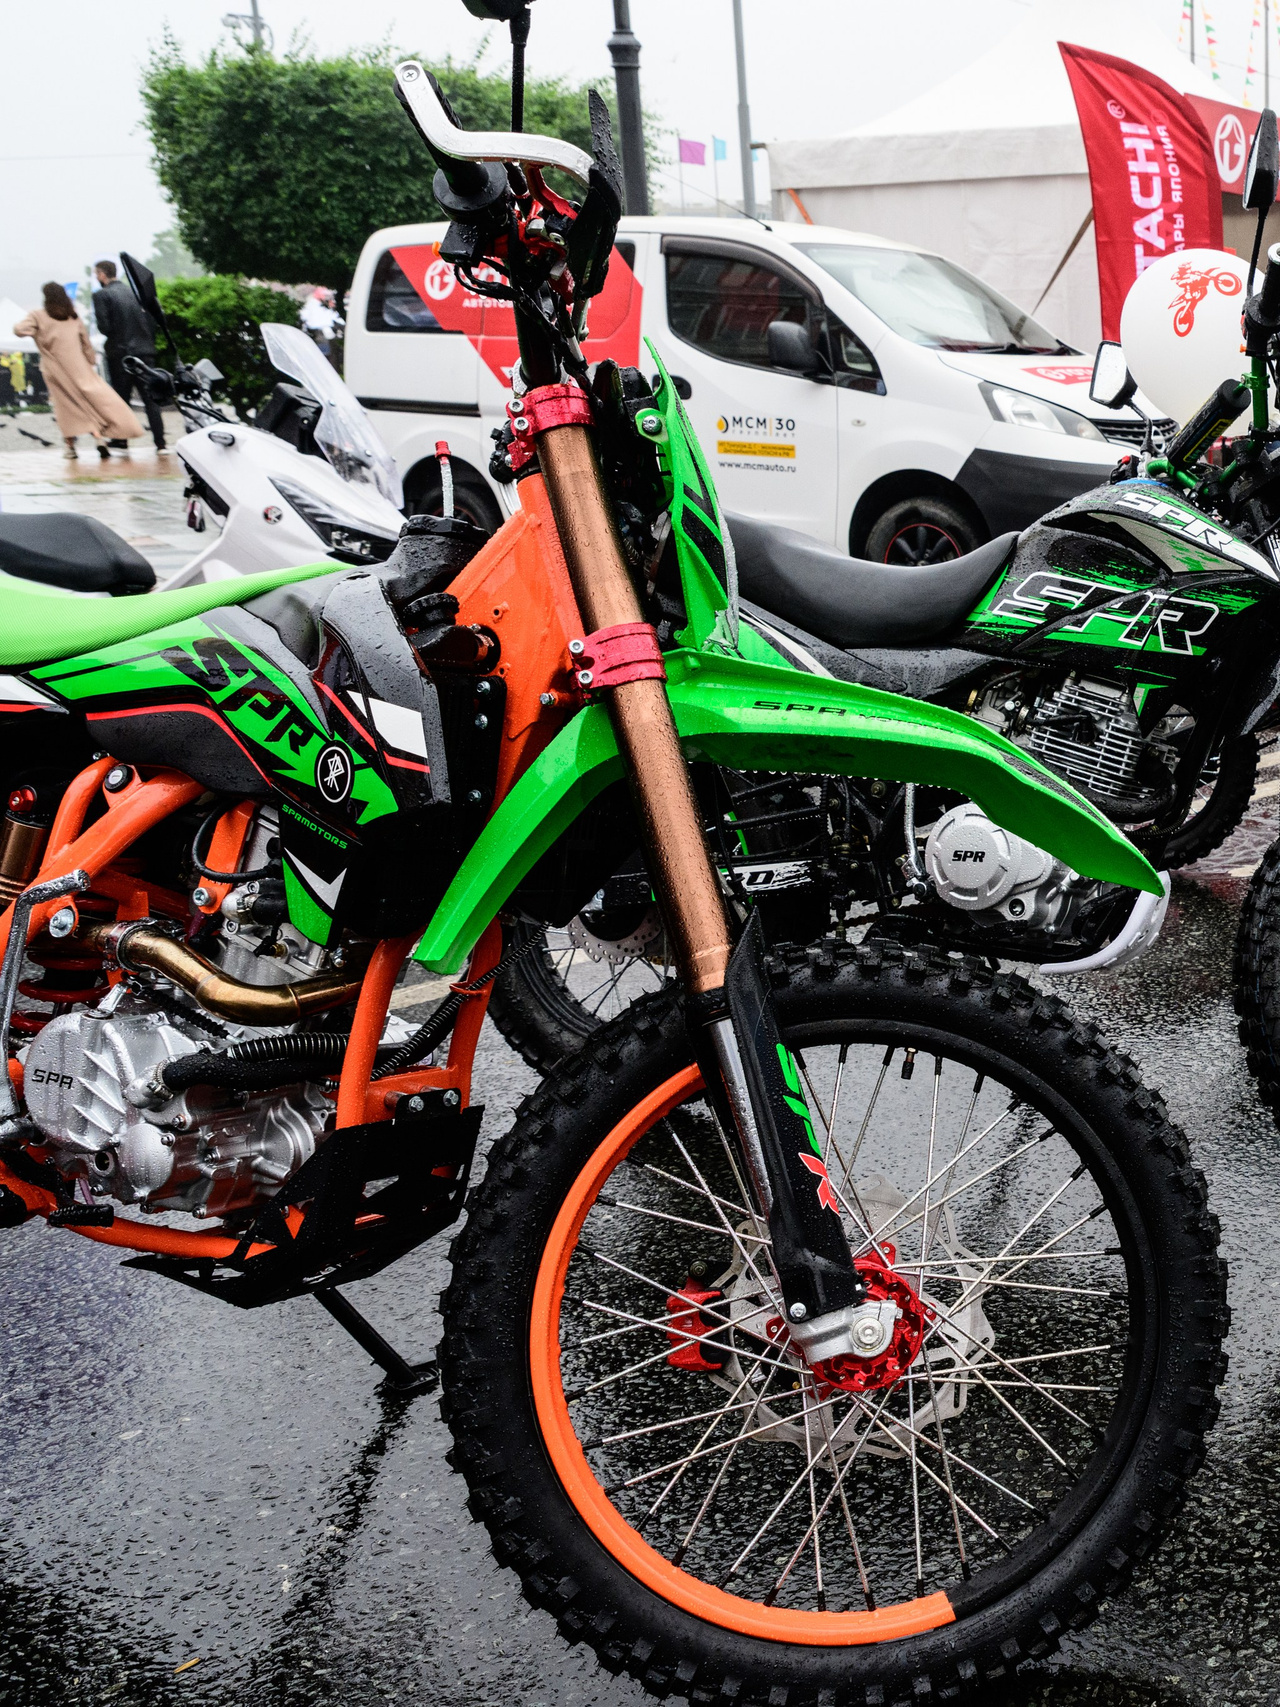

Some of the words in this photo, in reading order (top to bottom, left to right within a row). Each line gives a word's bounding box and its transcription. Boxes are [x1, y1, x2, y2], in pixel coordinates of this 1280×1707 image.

[1155, 125, 1184, 203] ЯПОНИЯ
[1119, 121, 1166, 278] TACHI
[775, 418, 796, 431] 30
[718, 461, 796, 473] www.mcmauto.ru
[1114, 492, 1234, 553] SPR
[991, 571, 1220, 656] SPR
[159, 636, 318, 757] SPR
[751, 700, 847, 717] SPR
[281, 803, 348, 850] SPRMOTORS
[951, 850, 986, 863] SPR
[31, 1068, 74, 1090] SPR
